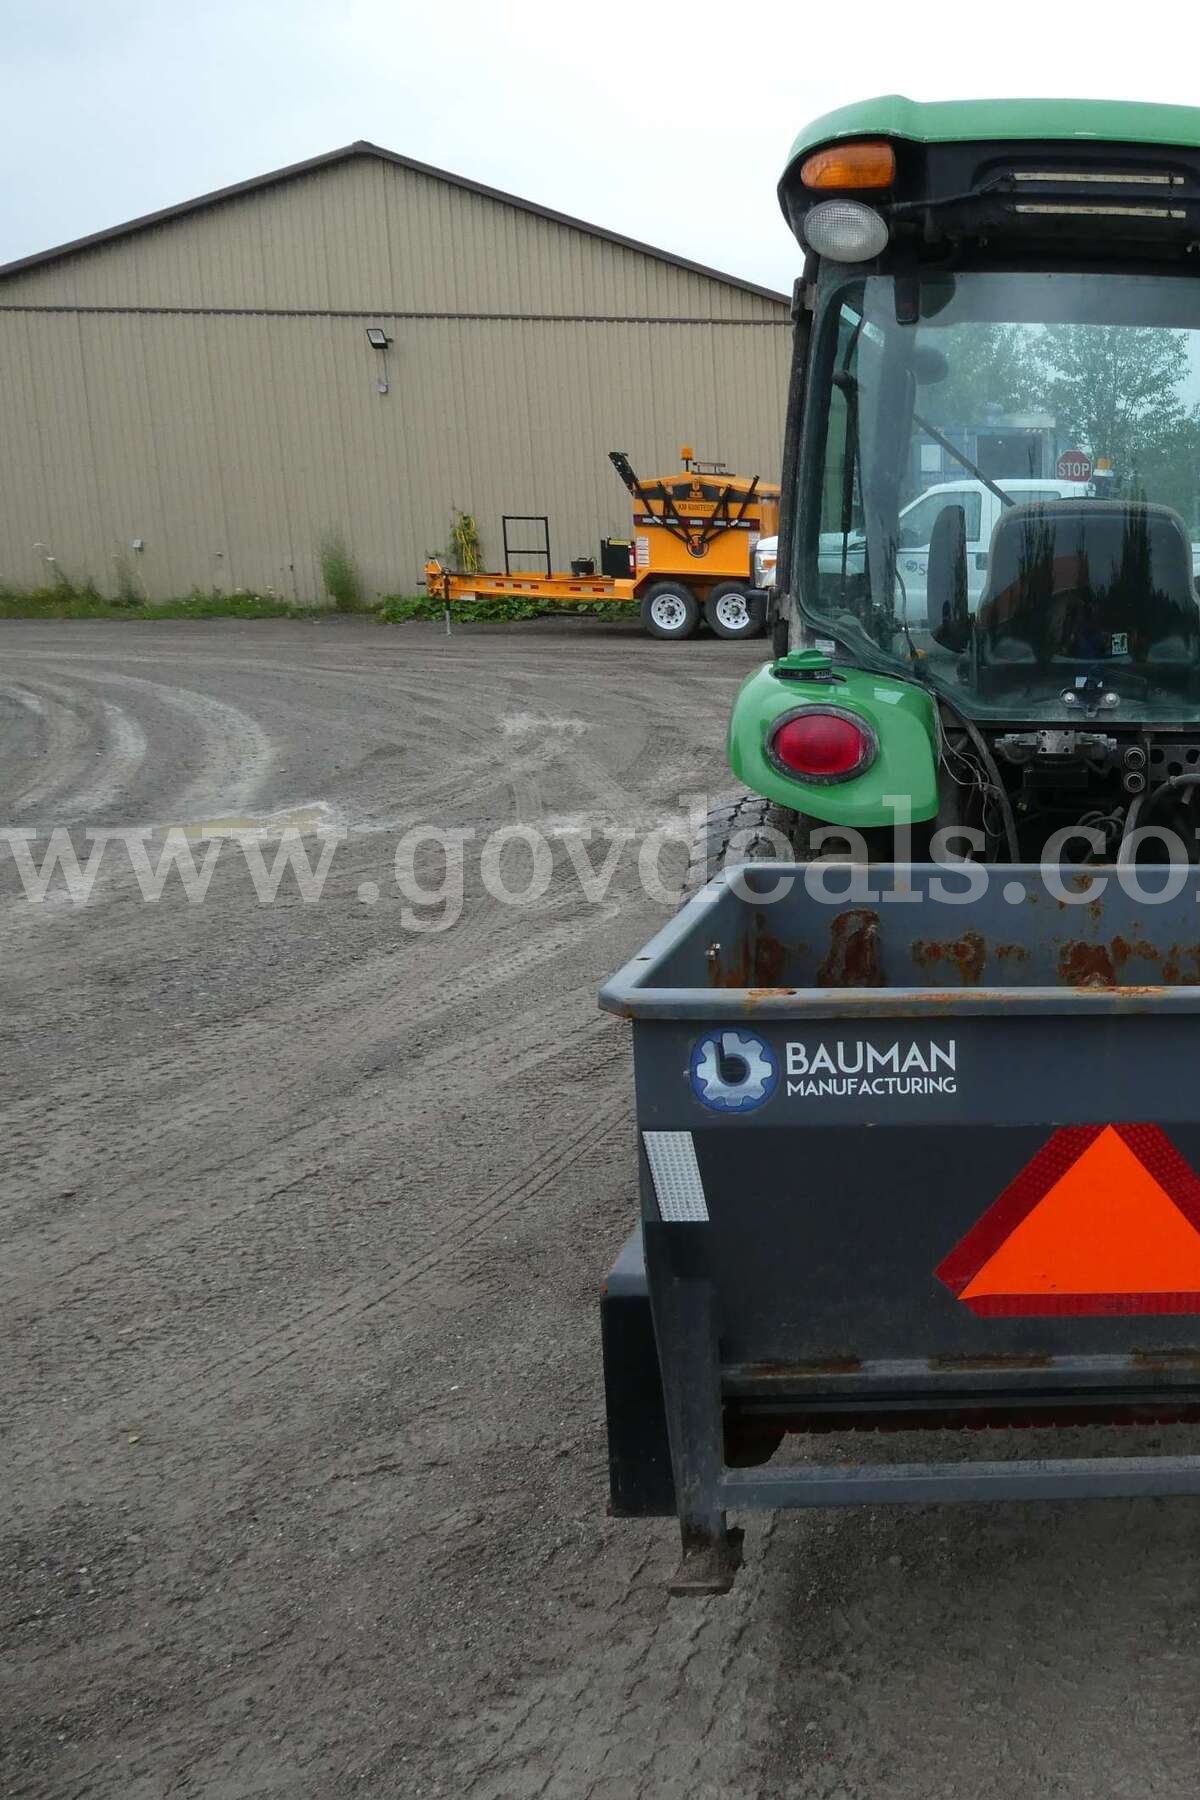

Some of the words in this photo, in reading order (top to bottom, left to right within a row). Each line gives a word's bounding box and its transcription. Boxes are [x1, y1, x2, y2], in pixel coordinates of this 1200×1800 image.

[1058, 463, 1089, 477] STOP
[786, 1039, 957, 1075] BAUMAN
[787, 1076, 957, 1097] MANUFACTURING
